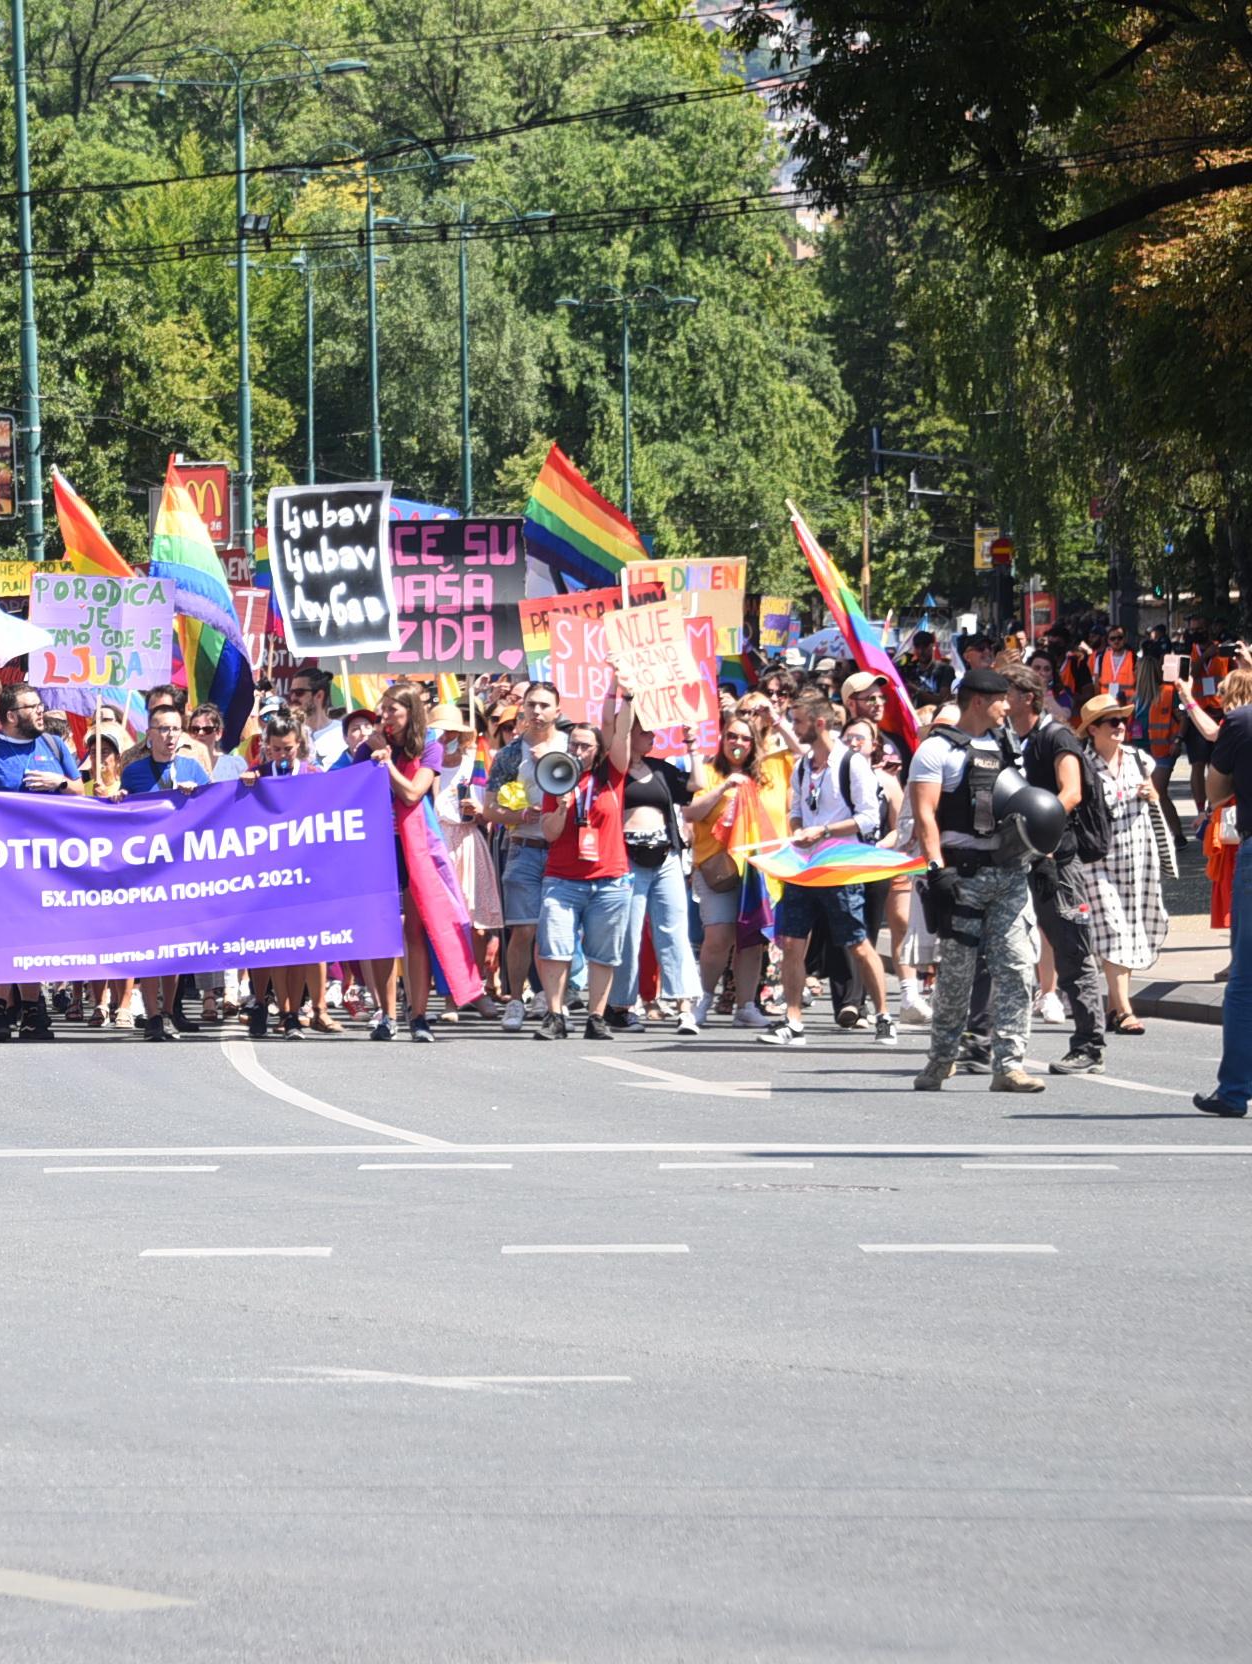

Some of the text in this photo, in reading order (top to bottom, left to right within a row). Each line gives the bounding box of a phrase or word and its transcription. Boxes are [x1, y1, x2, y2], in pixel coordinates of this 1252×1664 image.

[283, 499, 372, 539] ljubav
[283, 535, 375, 582] ljubav
[389, 525, 516, 566] CE SU
[79, 607, 110, 630] JE
[615, 609, 672, 649] NIJE
[142, 629, 162, 650] JE
[667, 664, 686, 681] JE
[637, 683, 685, 723] KVIR
[121, 834, 174, 865] СА
[183, 808, 366, 862] МАРГИНЕ
[41, 868, 311, 907] БХ.ПОВОРКА ПОНОСА 2021.
[13, 928, 353, 970] протестна шетња ЛГБТИ+ заједнице у БиХ
